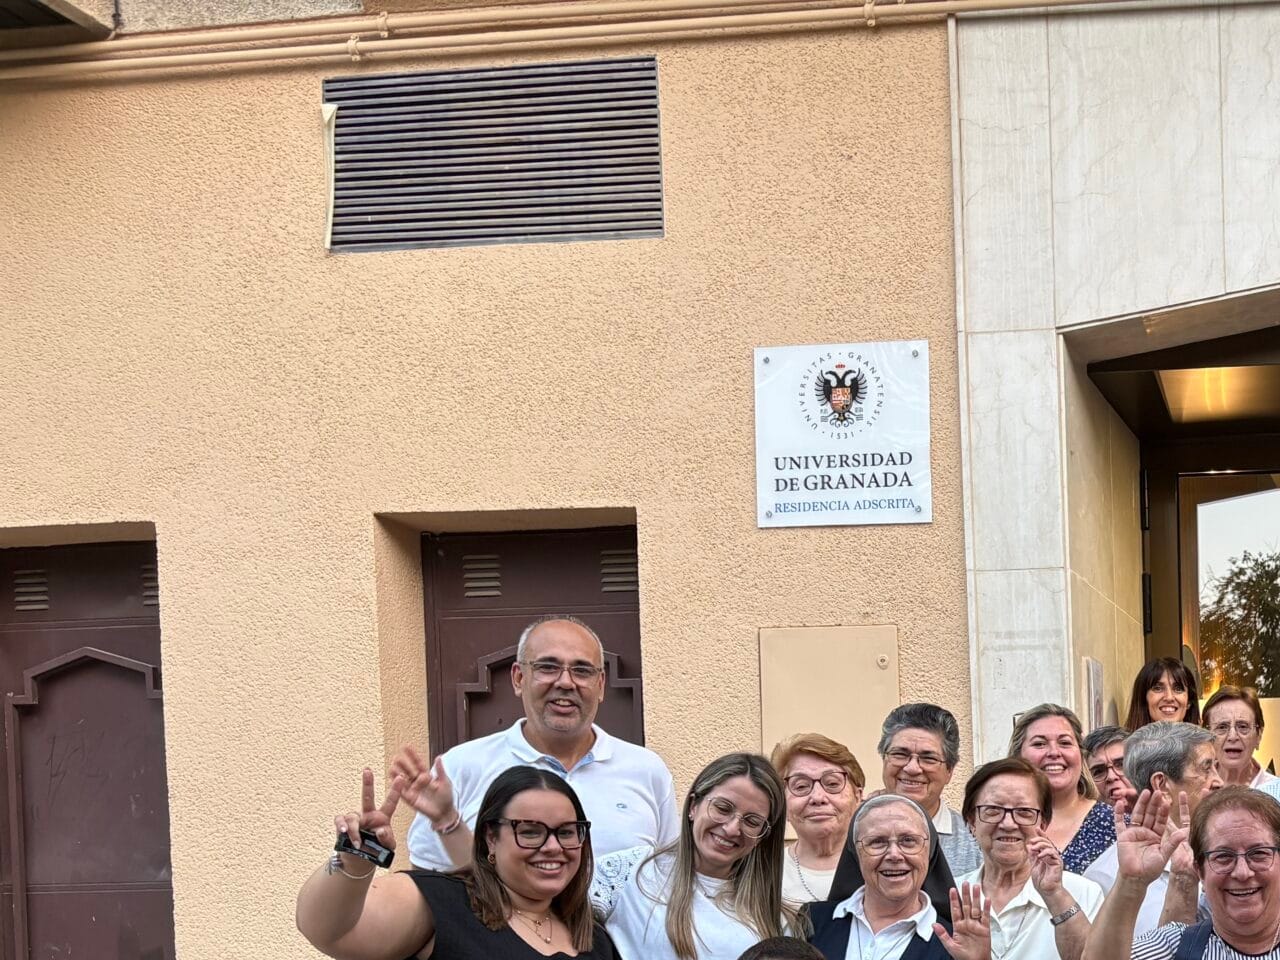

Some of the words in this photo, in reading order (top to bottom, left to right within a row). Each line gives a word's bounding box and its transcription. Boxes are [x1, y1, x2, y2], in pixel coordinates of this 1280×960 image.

[798, 352, 832, 430] UNIVERSITAS
[774, 451, 913, 471] UNIVERSIDAD
[774, 477, 800, 492] DE
[803, 471, 914, 491] GRANADA
[774, 499, 850, 514] RESIDENCIA
[853, 498, 915, 511] ADSCRITA
